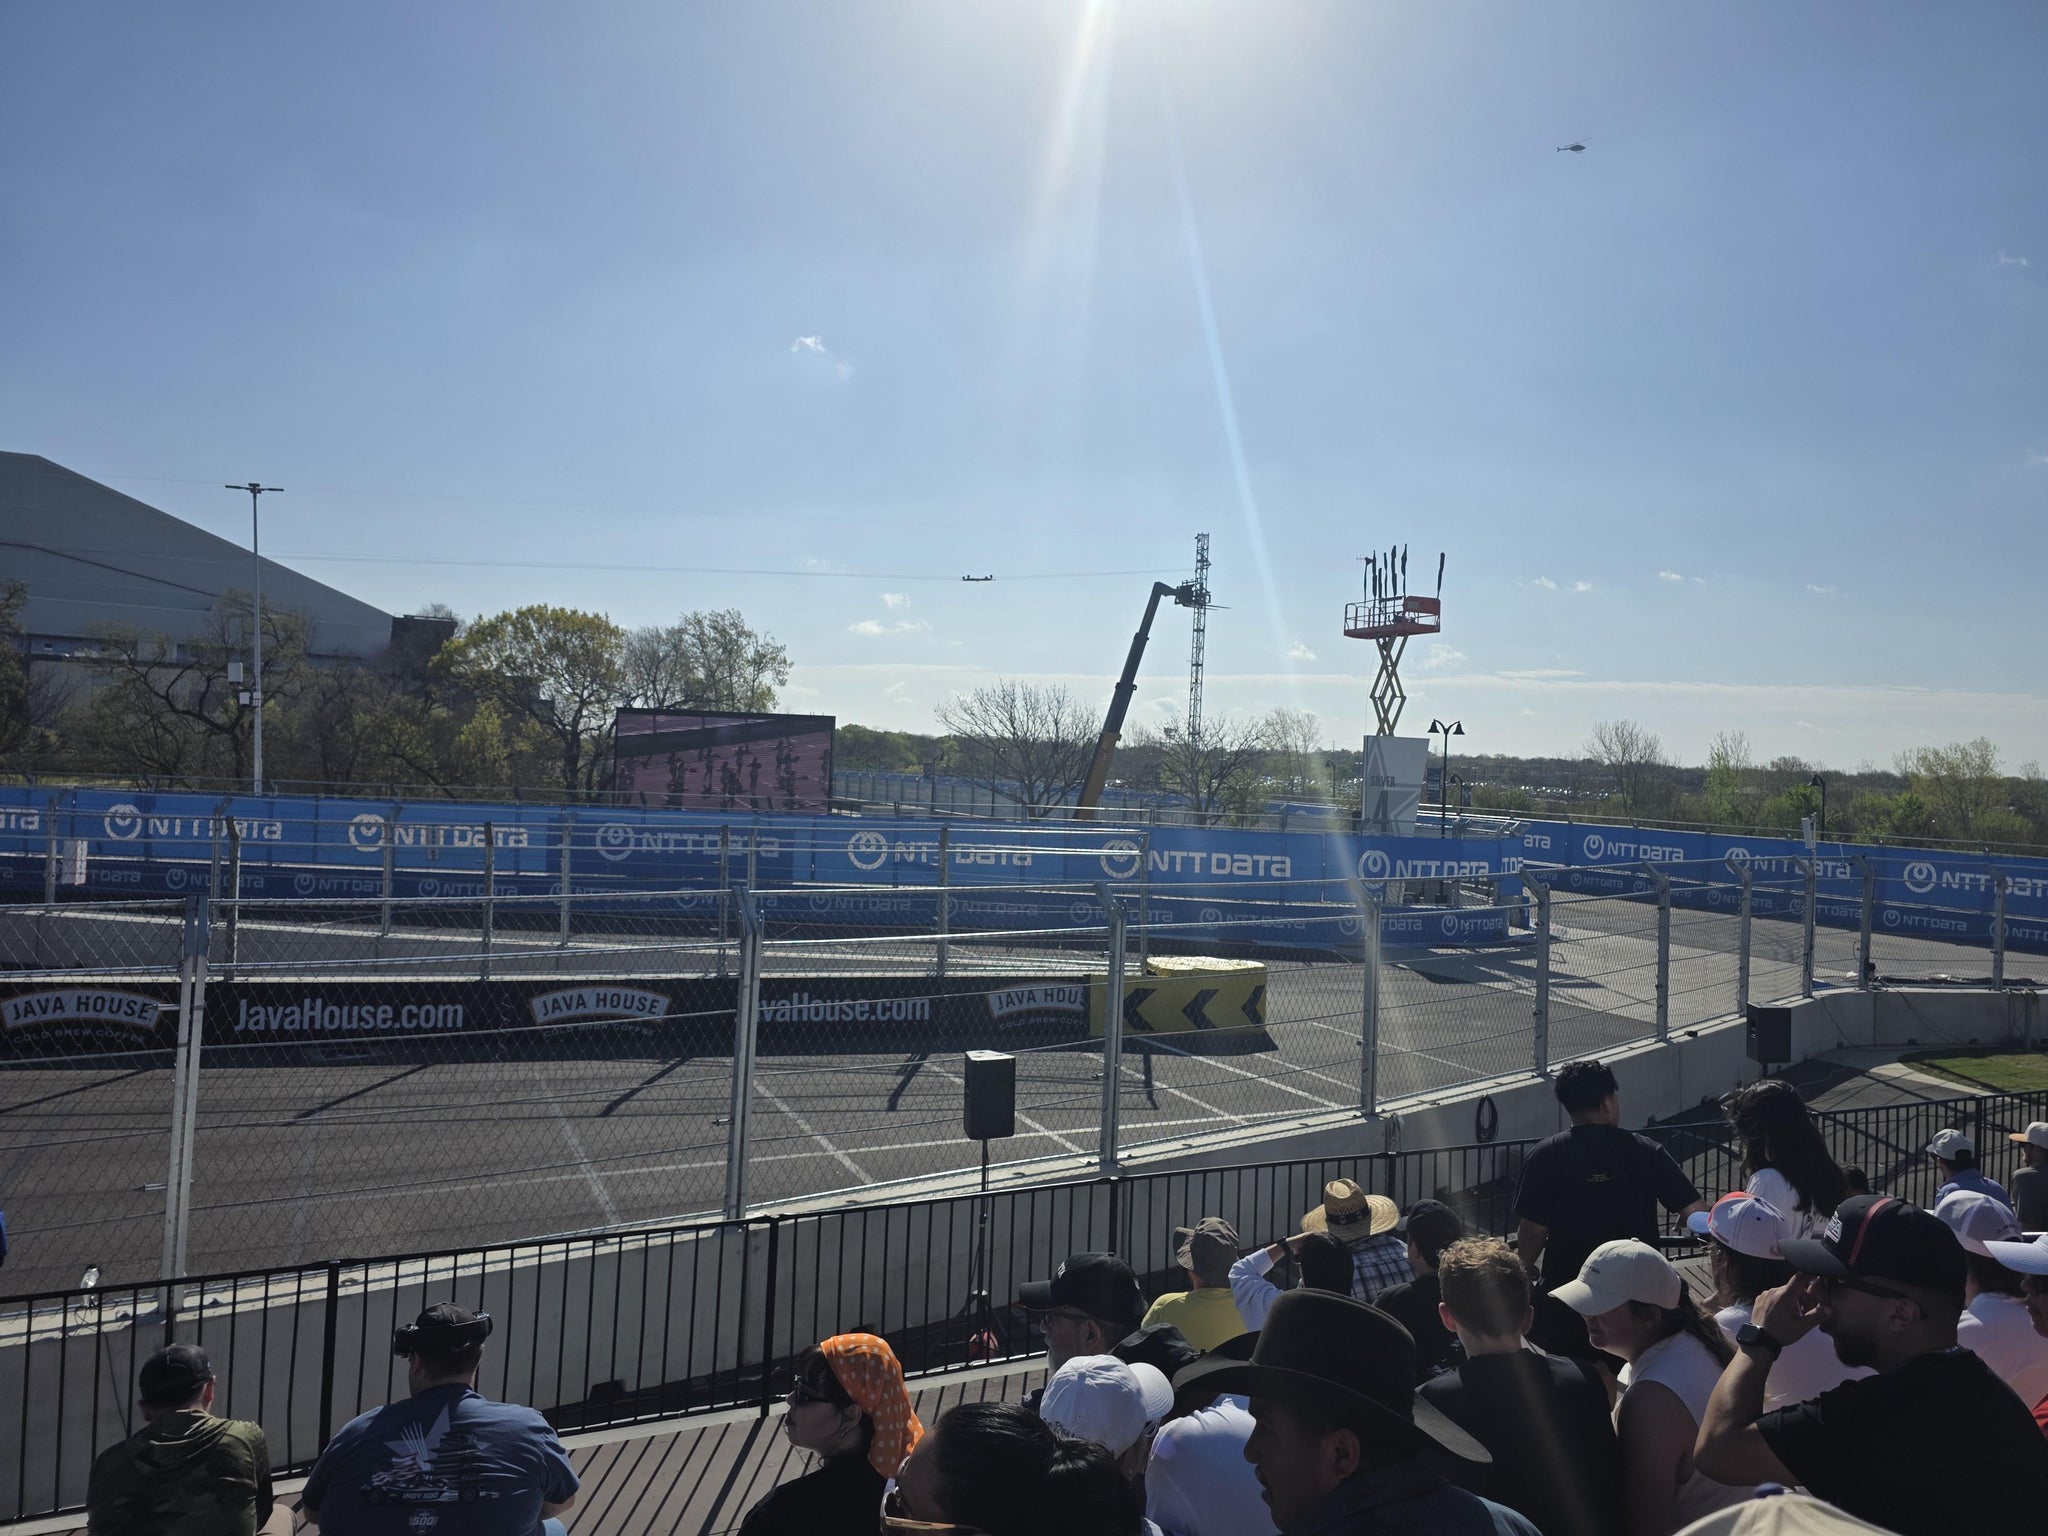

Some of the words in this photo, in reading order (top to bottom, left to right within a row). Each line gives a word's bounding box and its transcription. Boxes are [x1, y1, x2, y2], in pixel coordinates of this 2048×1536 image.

[1369, 775, 1396, 788] SILVER
[394, 823, 452, 846] NTT
[1606, 841, 1638, 858] NTT
[1639, 844, 1684, 862] DATA
[1148, 849, 1208, 874] NTT
[1210, 852, 1292, 878] DATA
[1395, 859, 1441, 878] NTT
[1442, 860, 1490, 882] DATA
[1754, 854, 1793, 873] NTT
[100, 869, 141, 884] DATA
[318, 878, 351, 893] NTT
[1941, 871, 1991, 892] NTT
[443, 883, 475, 896] NTT
[1389, 918, 1423, 932] DATA
[1903, 914, 1929, 927] NTT
[1930, 918, 1967, 932] DATA
[2011, 926, 2039, 940] NTT
[13, 997, 66, 1021] JAVA
[75, 995, 152, 1020] HOUSE
[542, 993, 587, 1017] JAVA
[595, 992, 660, 1015] HOUSE
[757, 992, 930, 1023] vaHouse.com
[998, 988, 1037, 1010] JAVA
[234, 998, 464, 1031] JavaHouse.com
[1000, 1018, 1025, 1030] COLD
[1029, 1016, 1056, 1024] BREW
[14, 1030, 49, 1044] COLD
[55, 1028, 92, 1037] BREW
[544, 1026, 574, 1038] COLD
[612, 1023, 656, 1037] COFFEE
